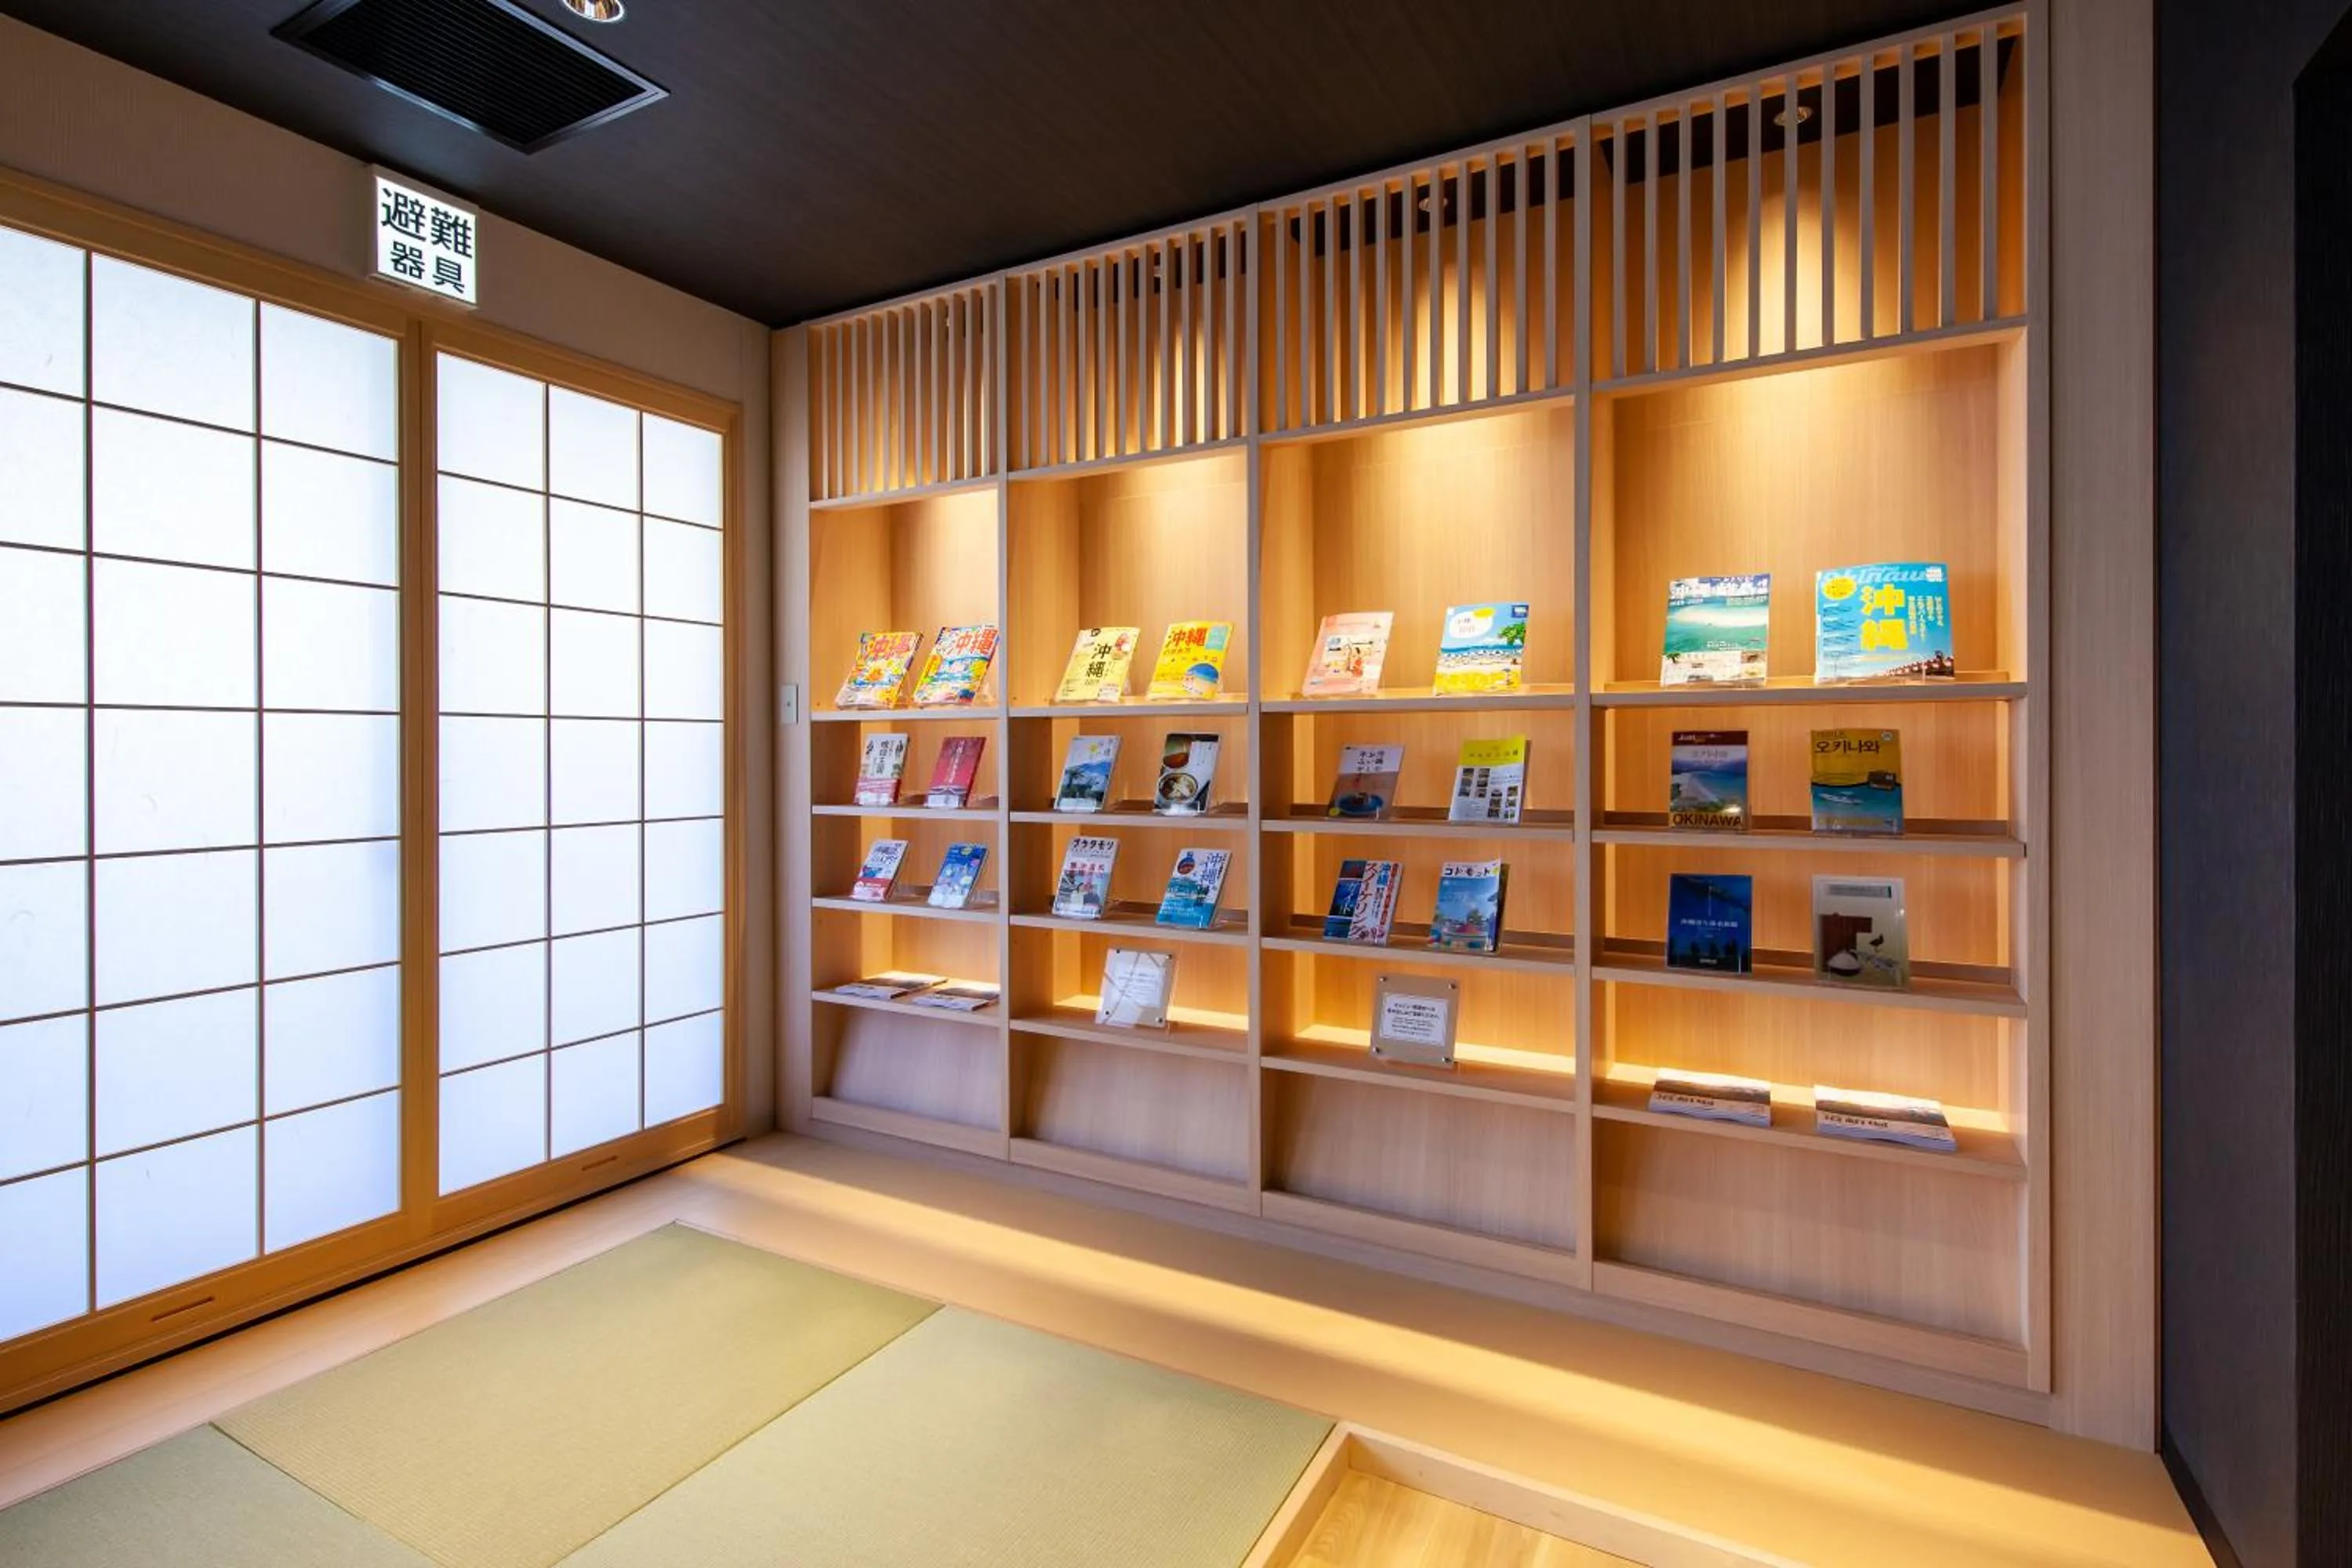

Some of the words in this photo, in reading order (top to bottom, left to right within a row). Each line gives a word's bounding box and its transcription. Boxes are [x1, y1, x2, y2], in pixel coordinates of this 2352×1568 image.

[381, 187, 472, 260] 避難
[390, 241, 465, 294] 器具
[1860, 583, 1908, 651] 沖縄
[1165, 627, 1208, 648] 沖縄
[1086, 643, 1112, 678] 沖縄
[1814, 739, 1880, 754] 오키나와
[1673, 813, 1744, 828] OKINAWA
